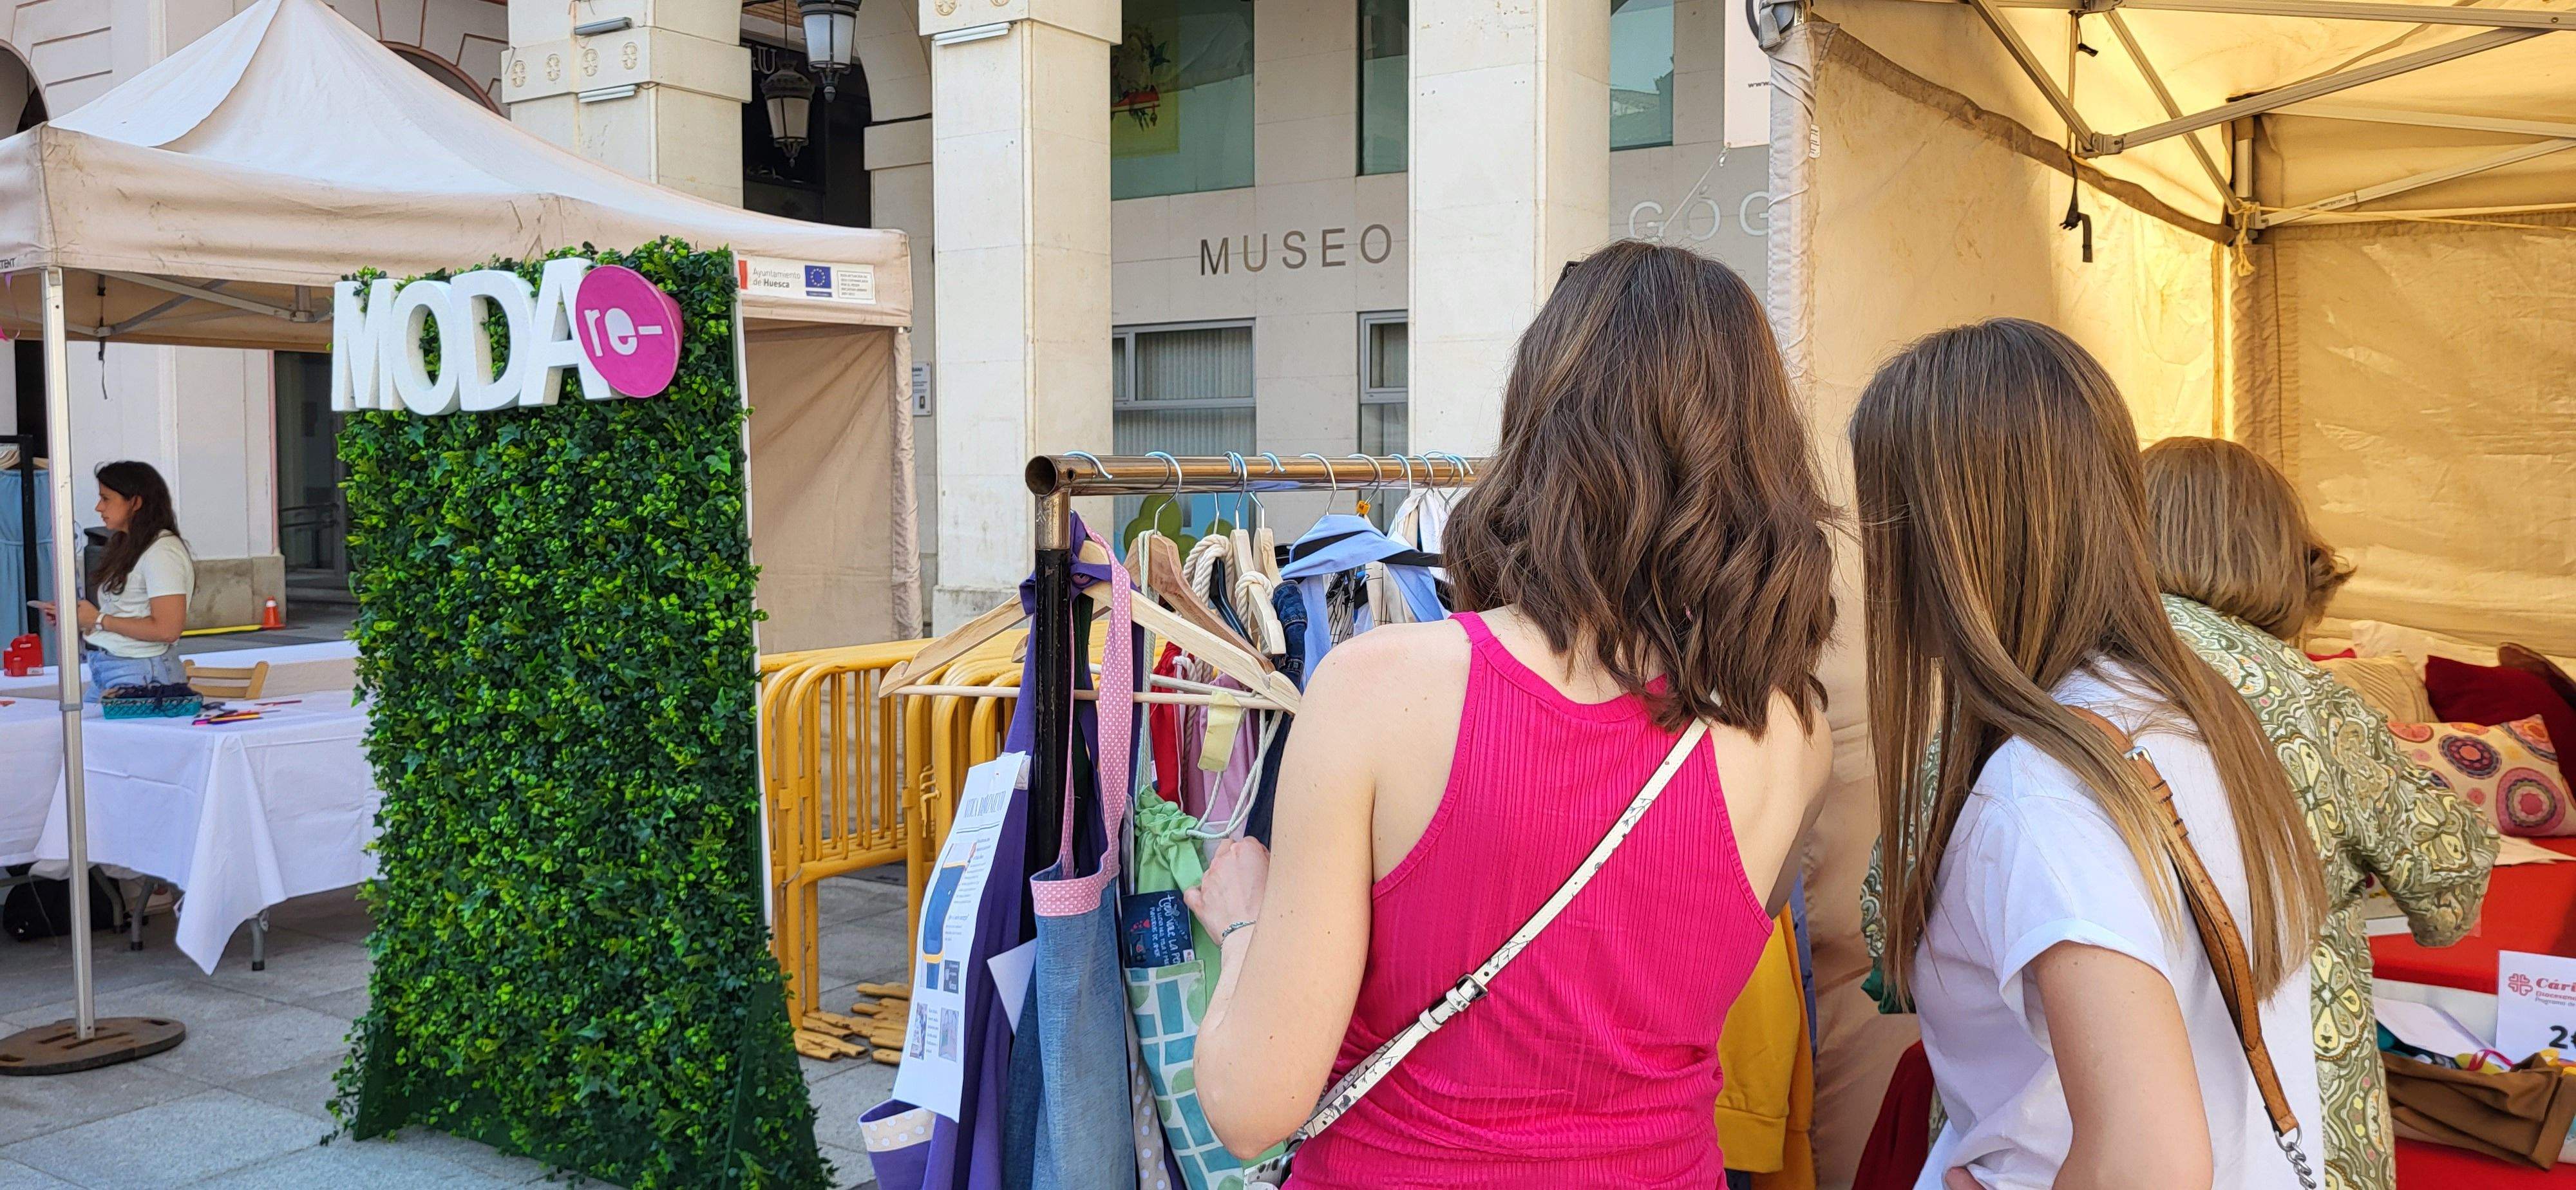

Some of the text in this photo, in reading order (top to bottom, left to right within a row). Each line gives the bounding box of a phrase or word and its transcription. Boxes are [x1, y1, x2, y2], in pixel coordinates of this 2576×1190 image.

[1200, 224, 1392, 276] MUSEO
[0, 258, 16, 269] TENT
[753, 268, 801, 279] Ayuntamiento
[764, 279, 790, 288] Huesca
[332, 258, 621, 415] MODA
